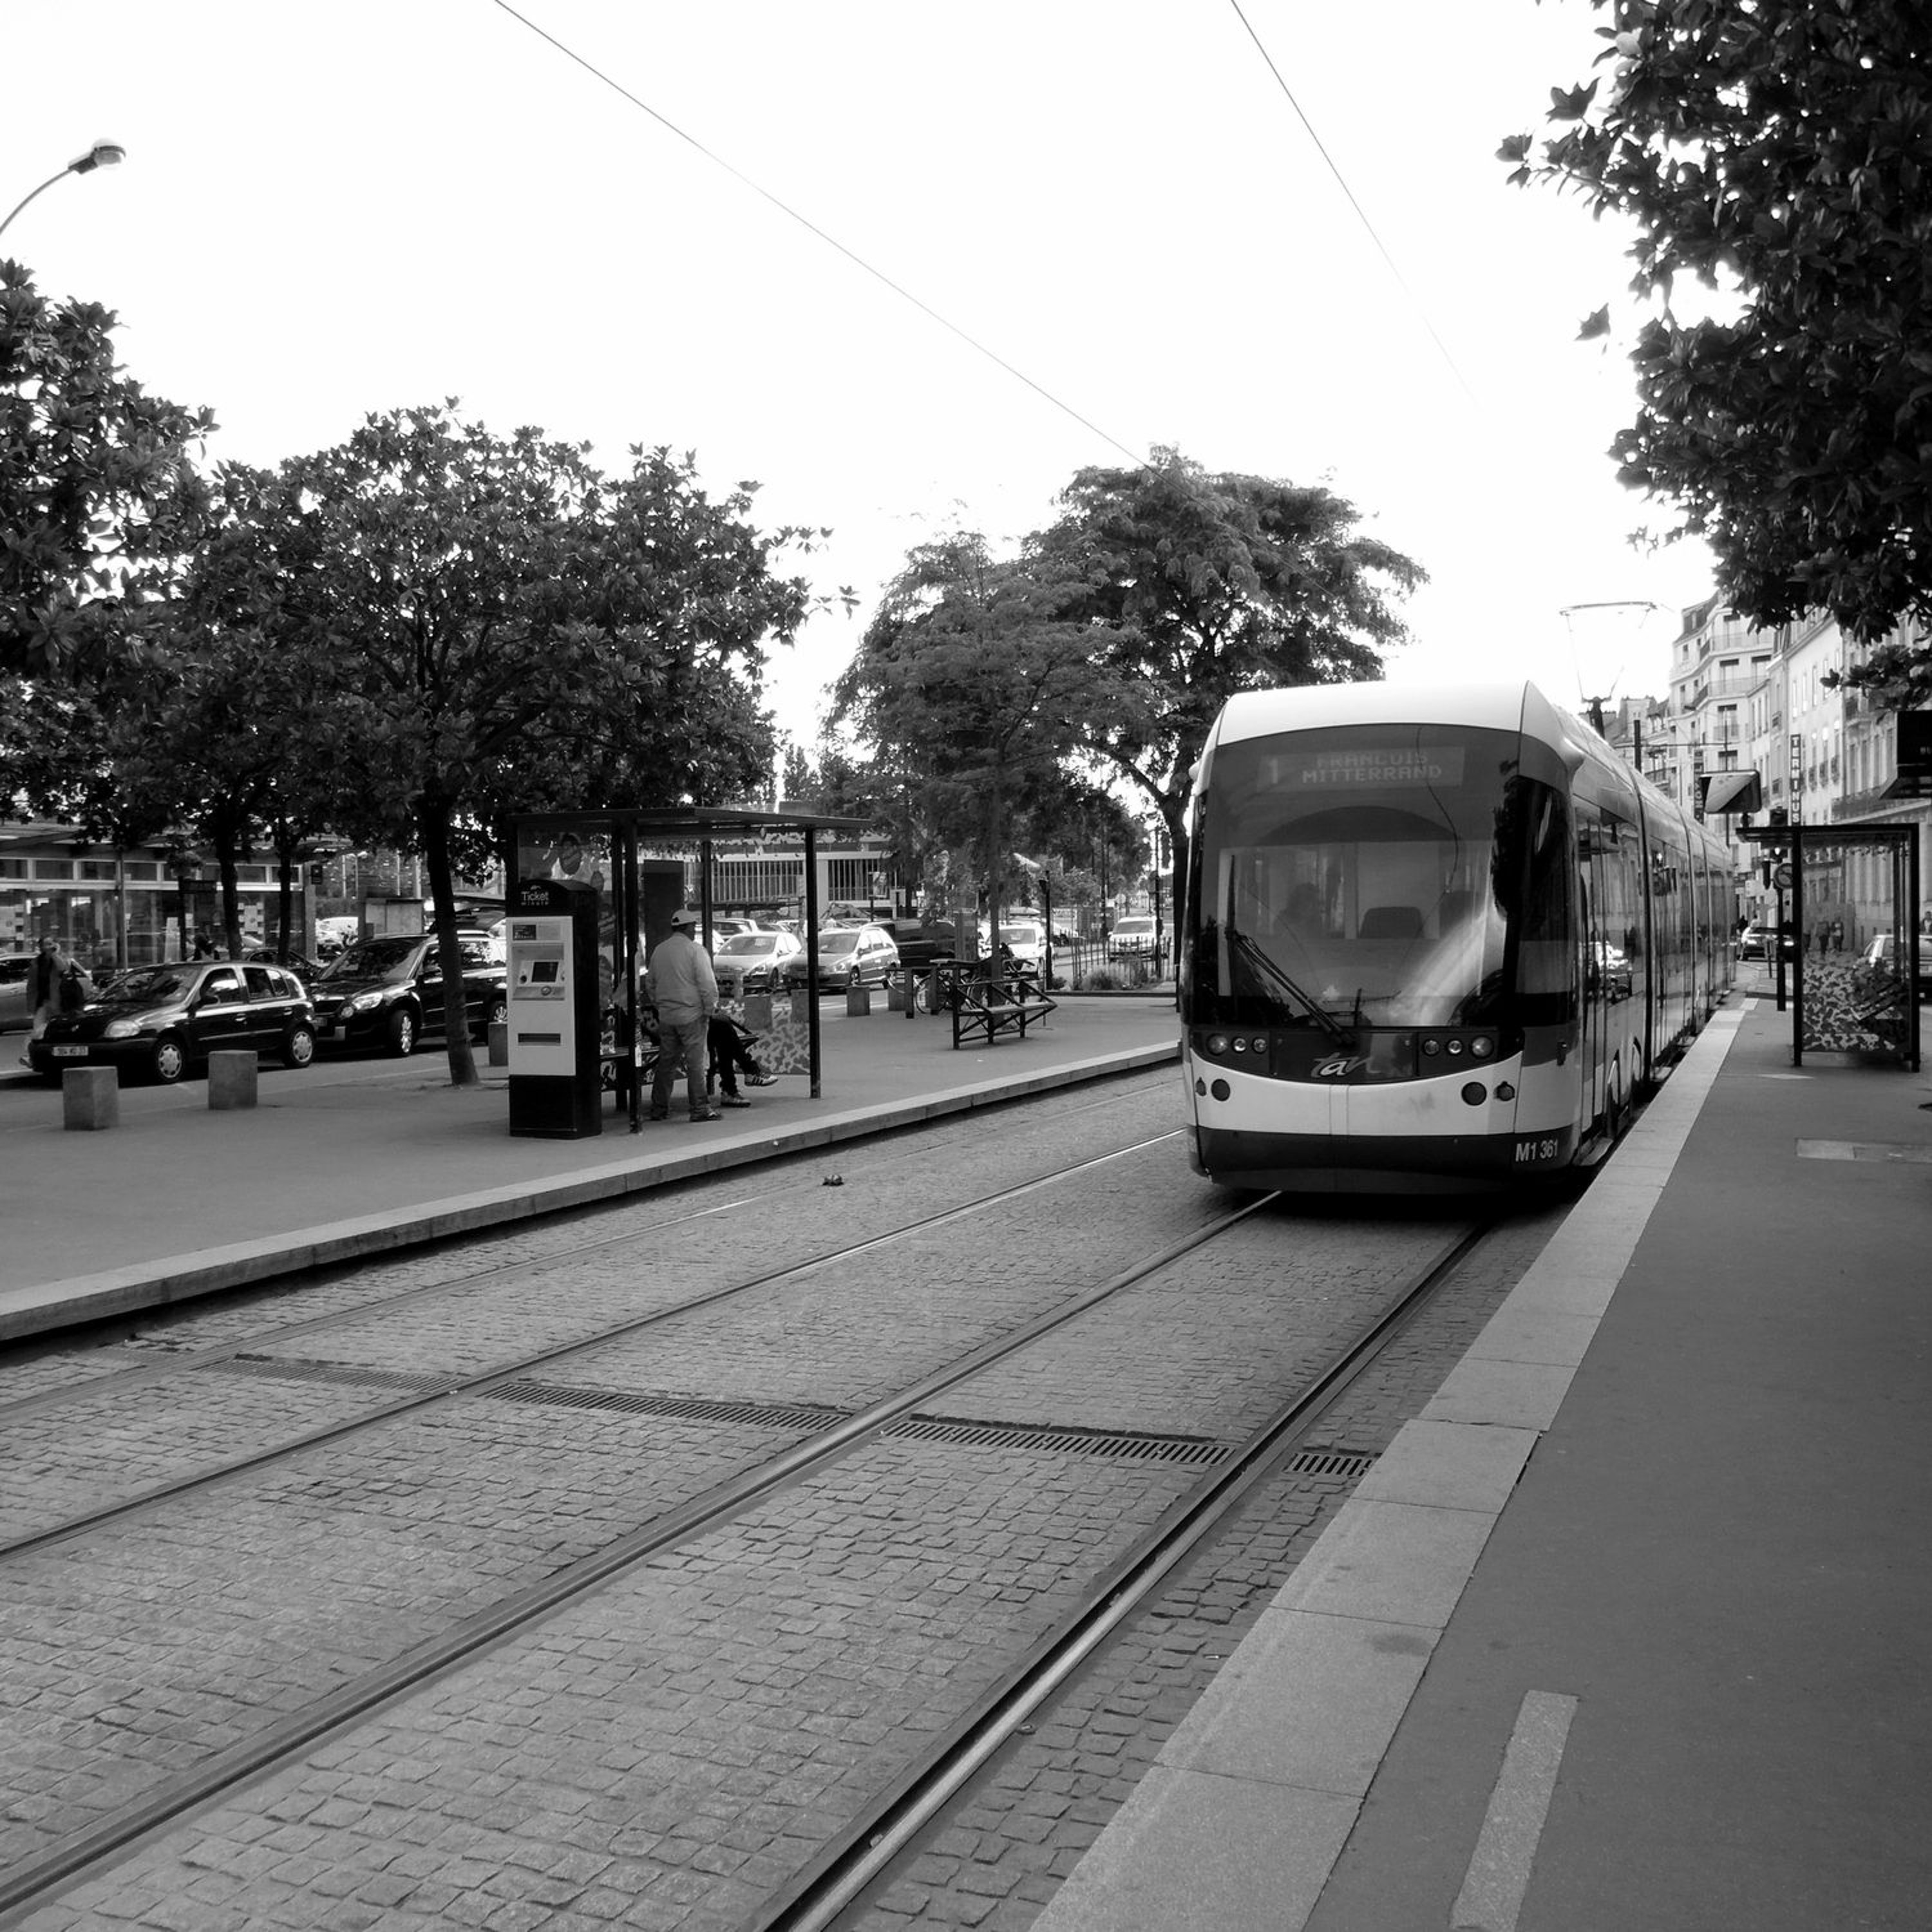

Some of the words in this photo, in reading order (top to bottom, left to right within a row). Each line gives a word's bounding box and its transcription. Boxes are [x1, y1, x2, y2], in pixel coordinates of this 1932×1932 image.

[1267, 757, 1278, 784] 1
[1302, 764, 1442, 784] MITTERRAND
[1792, 737, 1800, 823] TERMINUS
[520, 891, 549, 900] Ticket
[1311, 1052, 1381, 1079] tan
[1515, 1142, 1537, 1162] M1
[1540, 1139, 1558, 1159] 361
